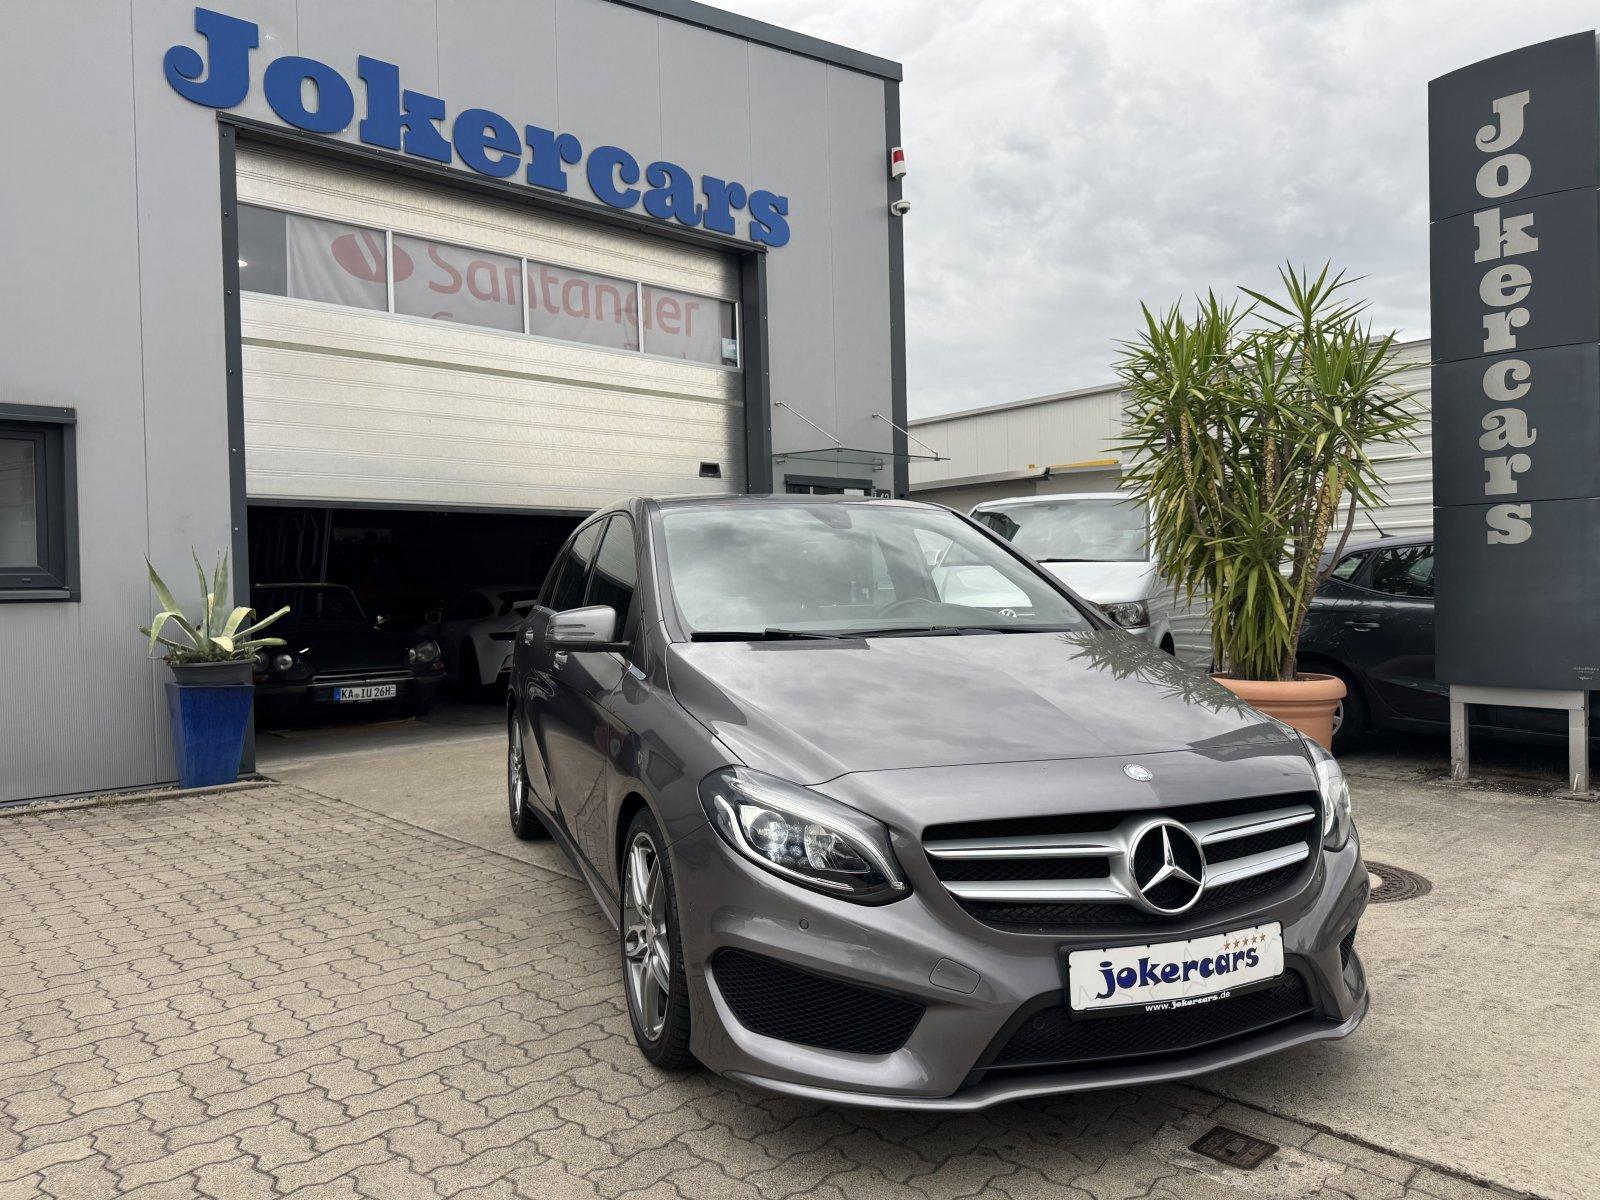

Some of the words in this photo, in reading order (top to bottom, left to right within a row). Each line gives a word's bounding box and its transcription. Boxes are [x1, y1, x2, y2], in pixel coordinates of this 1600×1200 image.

[163, 6, 790, 247] Jokercars
[428, 243, 699, 337] Santander
[1474, 90, 1538, 544] Jokercars
[341, 689, 354, 699] KA
[1095, 947, 1259, 1000] jokercars
